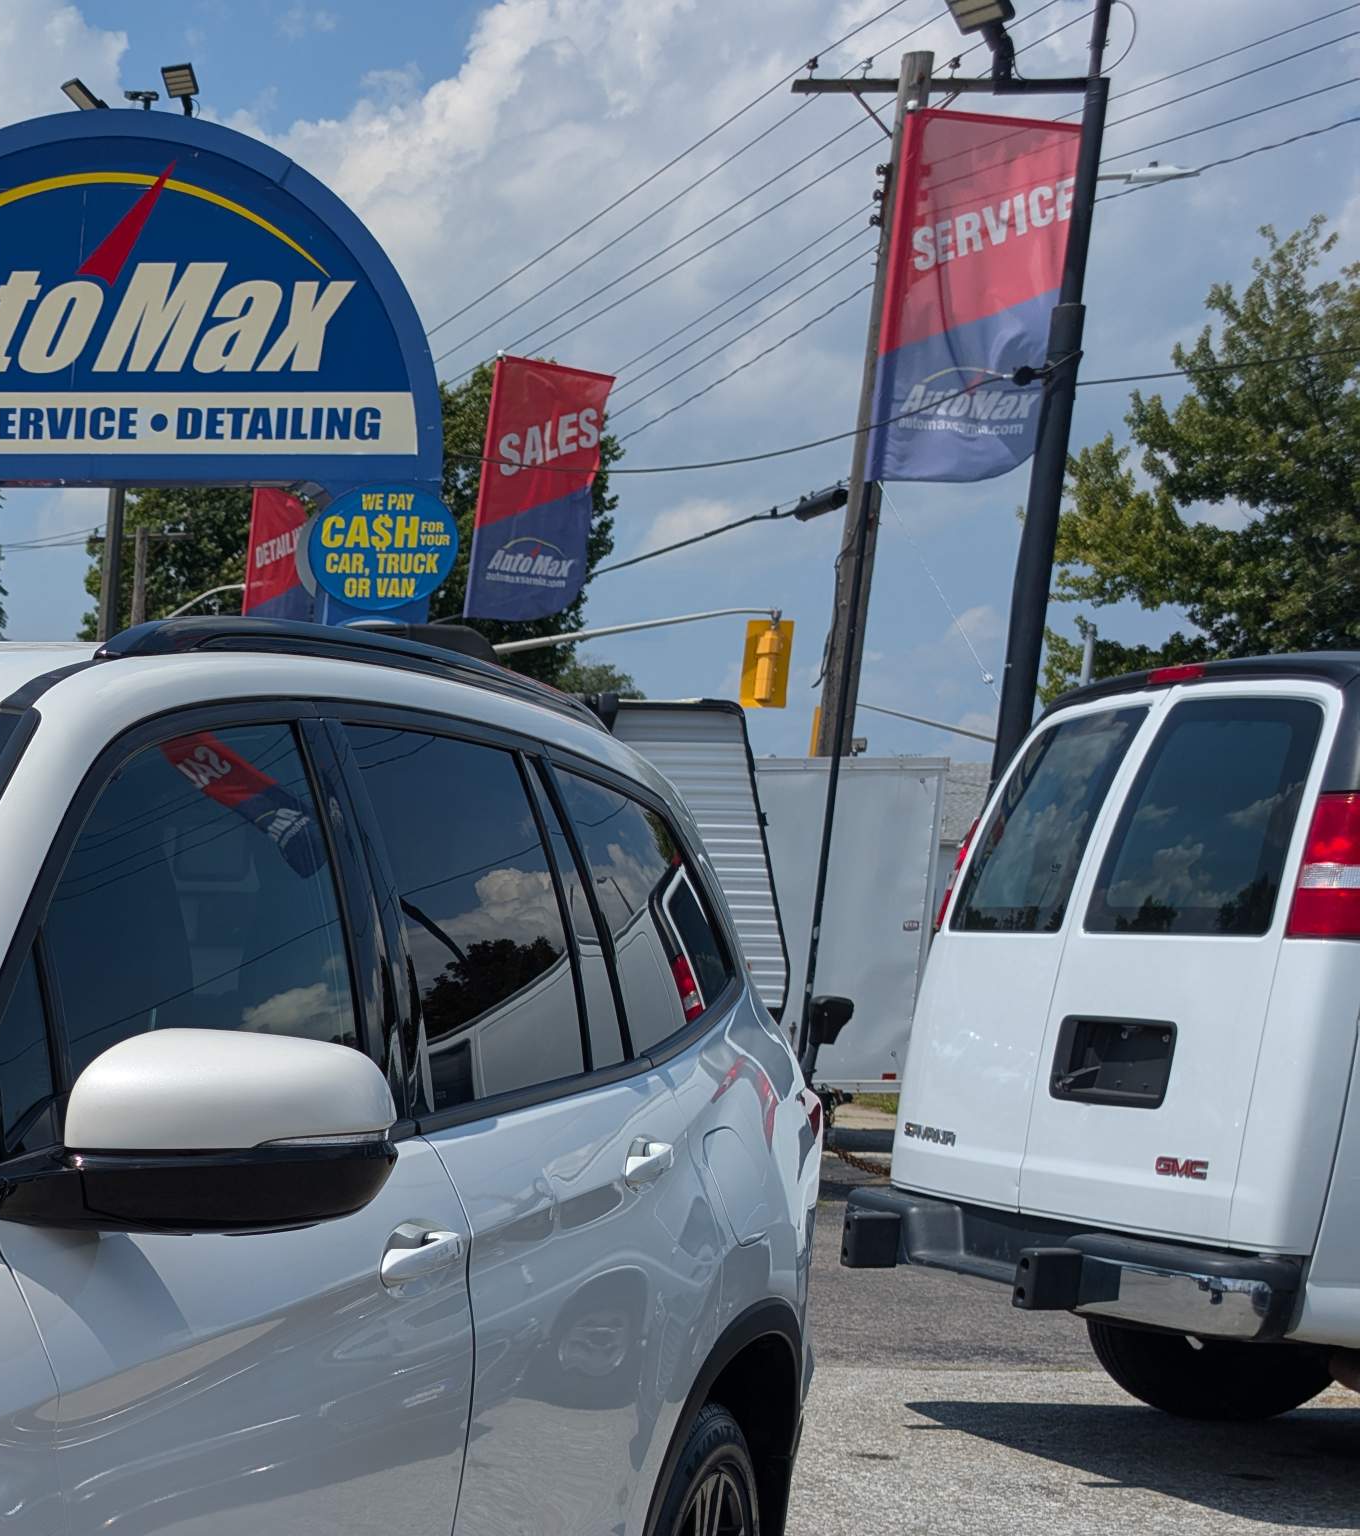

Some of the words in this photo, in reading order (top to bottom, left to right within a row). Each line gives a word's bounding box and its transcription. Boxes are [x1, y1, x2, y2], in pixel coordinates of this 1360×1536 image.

[912, 176, 1075, 271] SERVICE
[900, 384, 1041, 420] AutoMax
[176, 406, 381, 441] DETAILING
[898, 416, 1023, 435] automaxsarnia.com
[498, 408, 599, 476] SALES
[361, 493, 383, 511] WE
[387, 493, 415, 511] PAY
[321, 514, 420, 551] CA$H
[420, 534, 450, 546] YOUR
[421, 521, 444, 533] FOR
[325, 553, 370, 576] CAR,
[377, 553, 439, 574] TRUCK
[488, 549, 575, 578] AutoMax
[344, 578, 371, 598] OR
[376, 578, 416, 598] VAN
[1155, 1155, 1209, 1181] GMC
